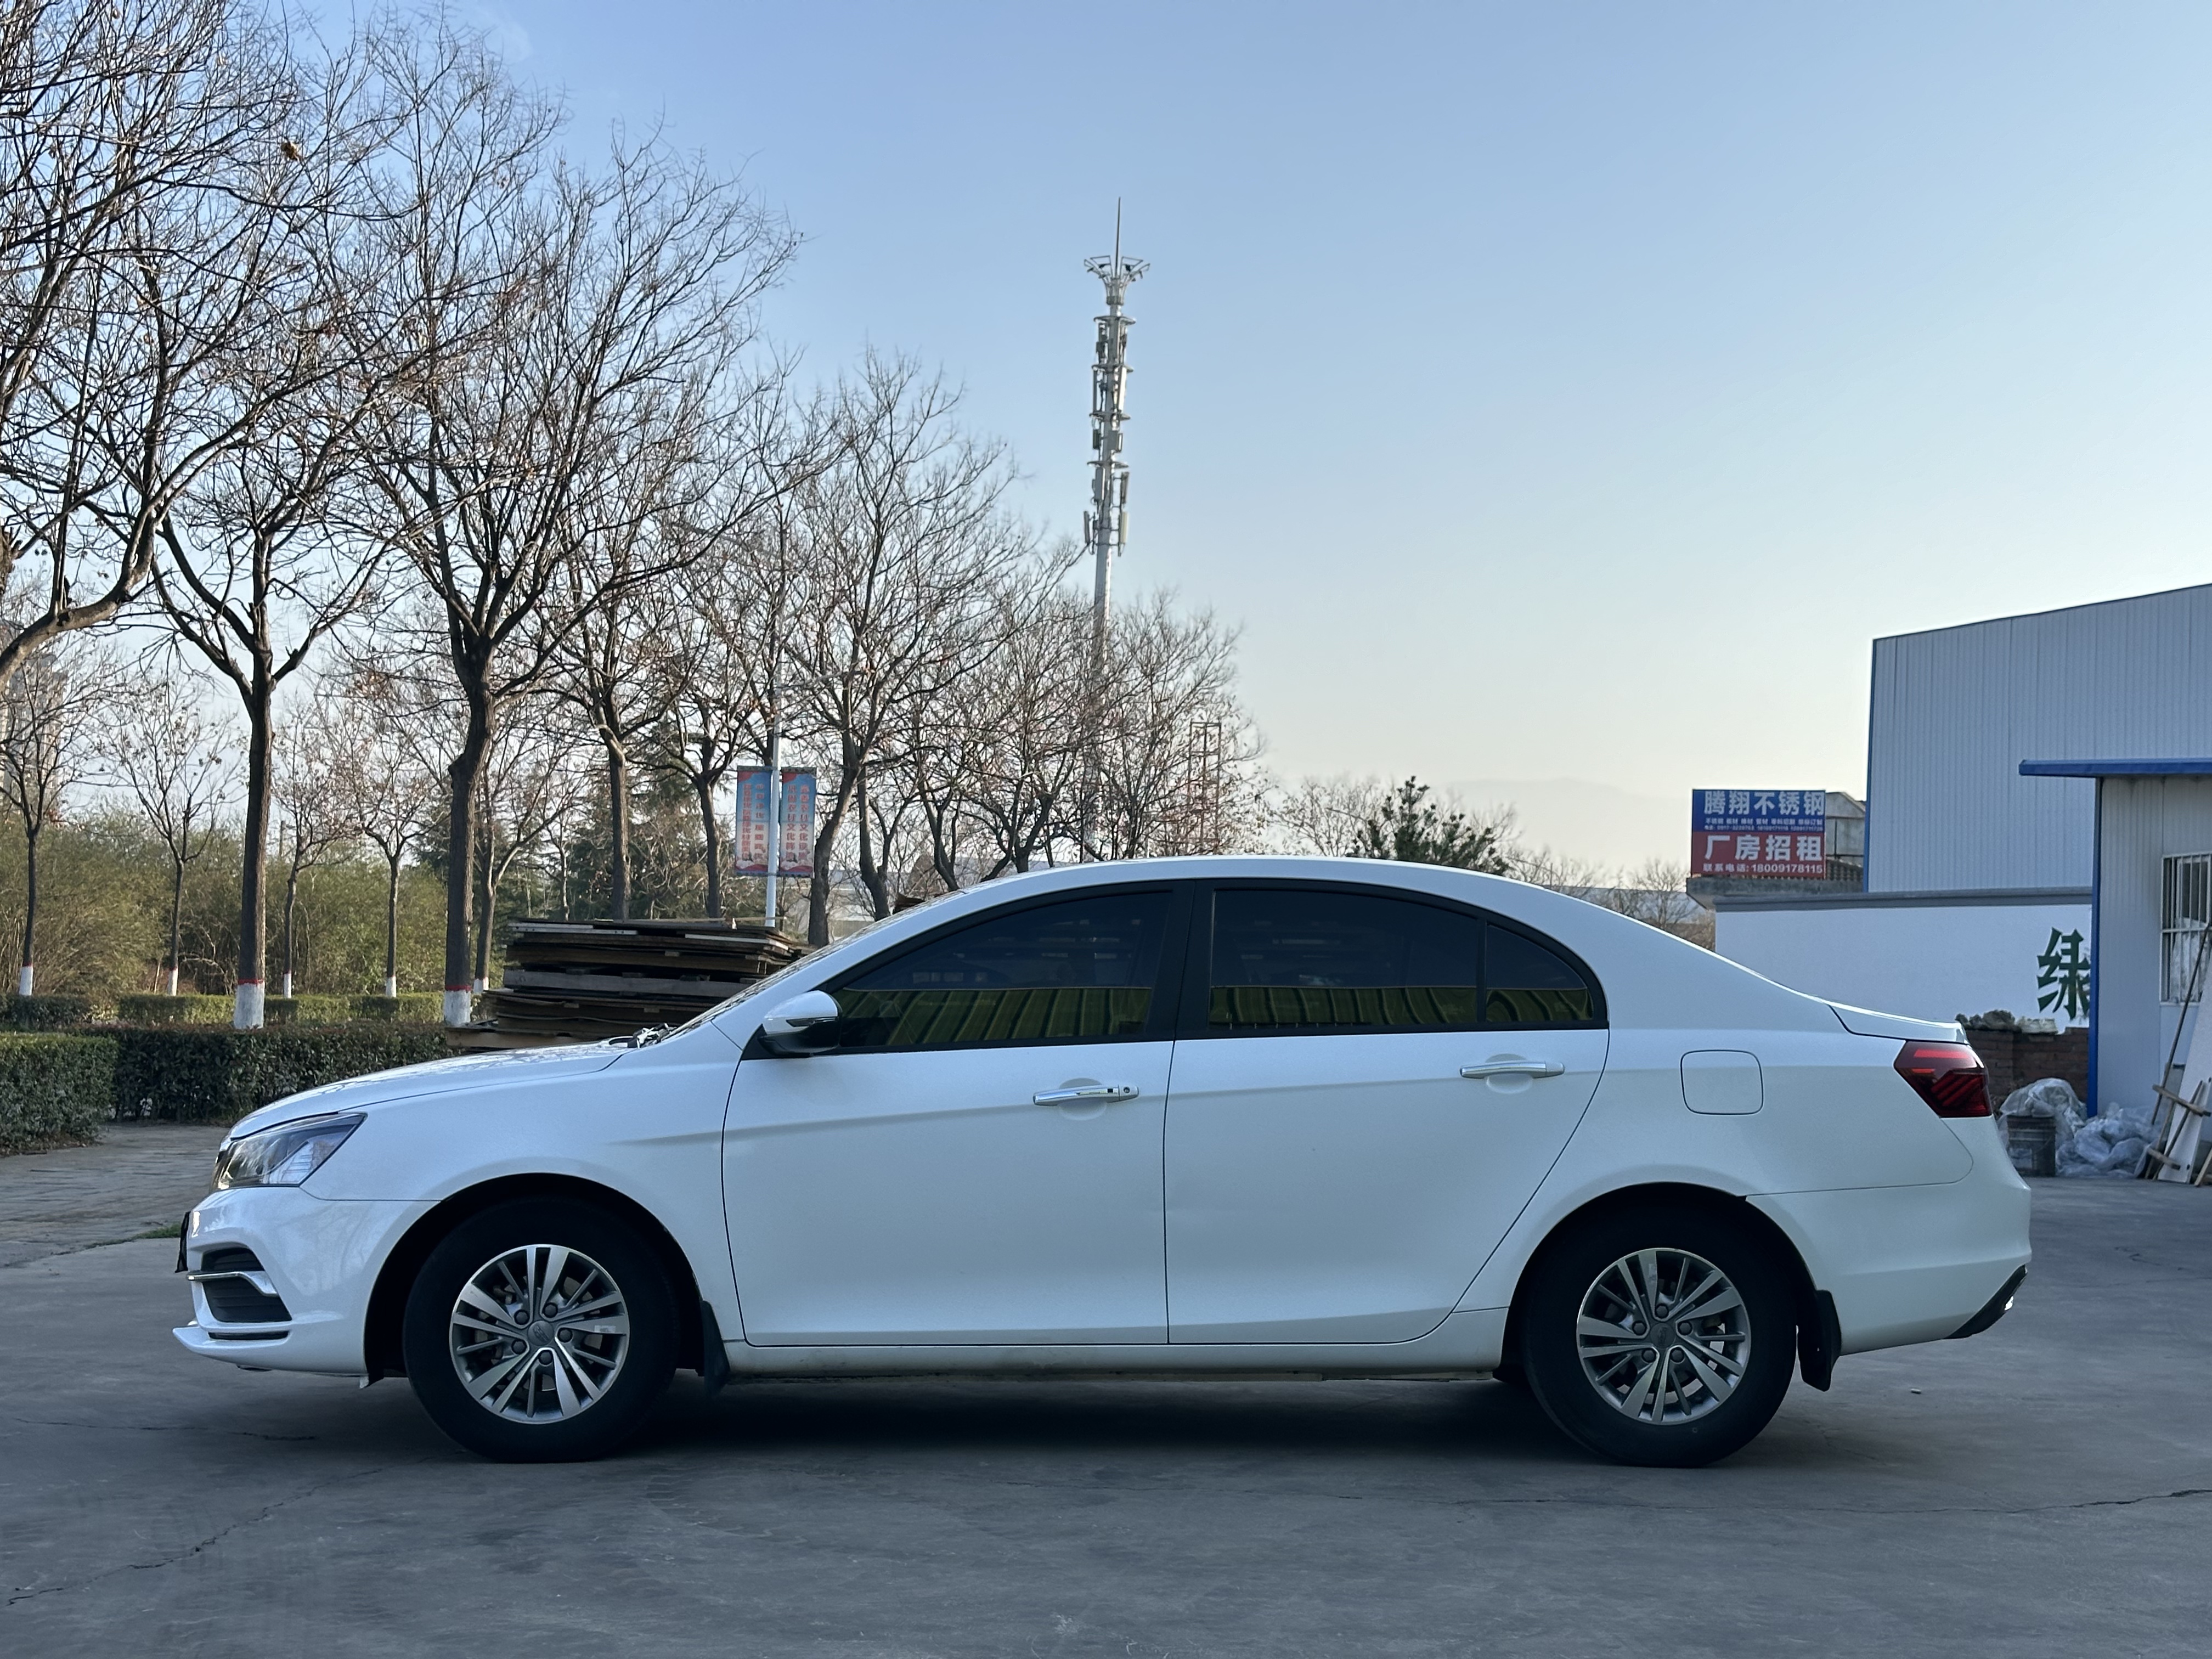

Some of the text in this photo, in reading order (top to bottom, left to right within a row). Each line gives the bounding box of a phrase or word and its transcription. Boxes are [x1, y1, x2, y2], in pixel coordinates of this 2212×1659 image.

[1703, 791, 1825, 816] 腾翔不锈钢
[1705, 834, 1822, 861] 厂房招租
